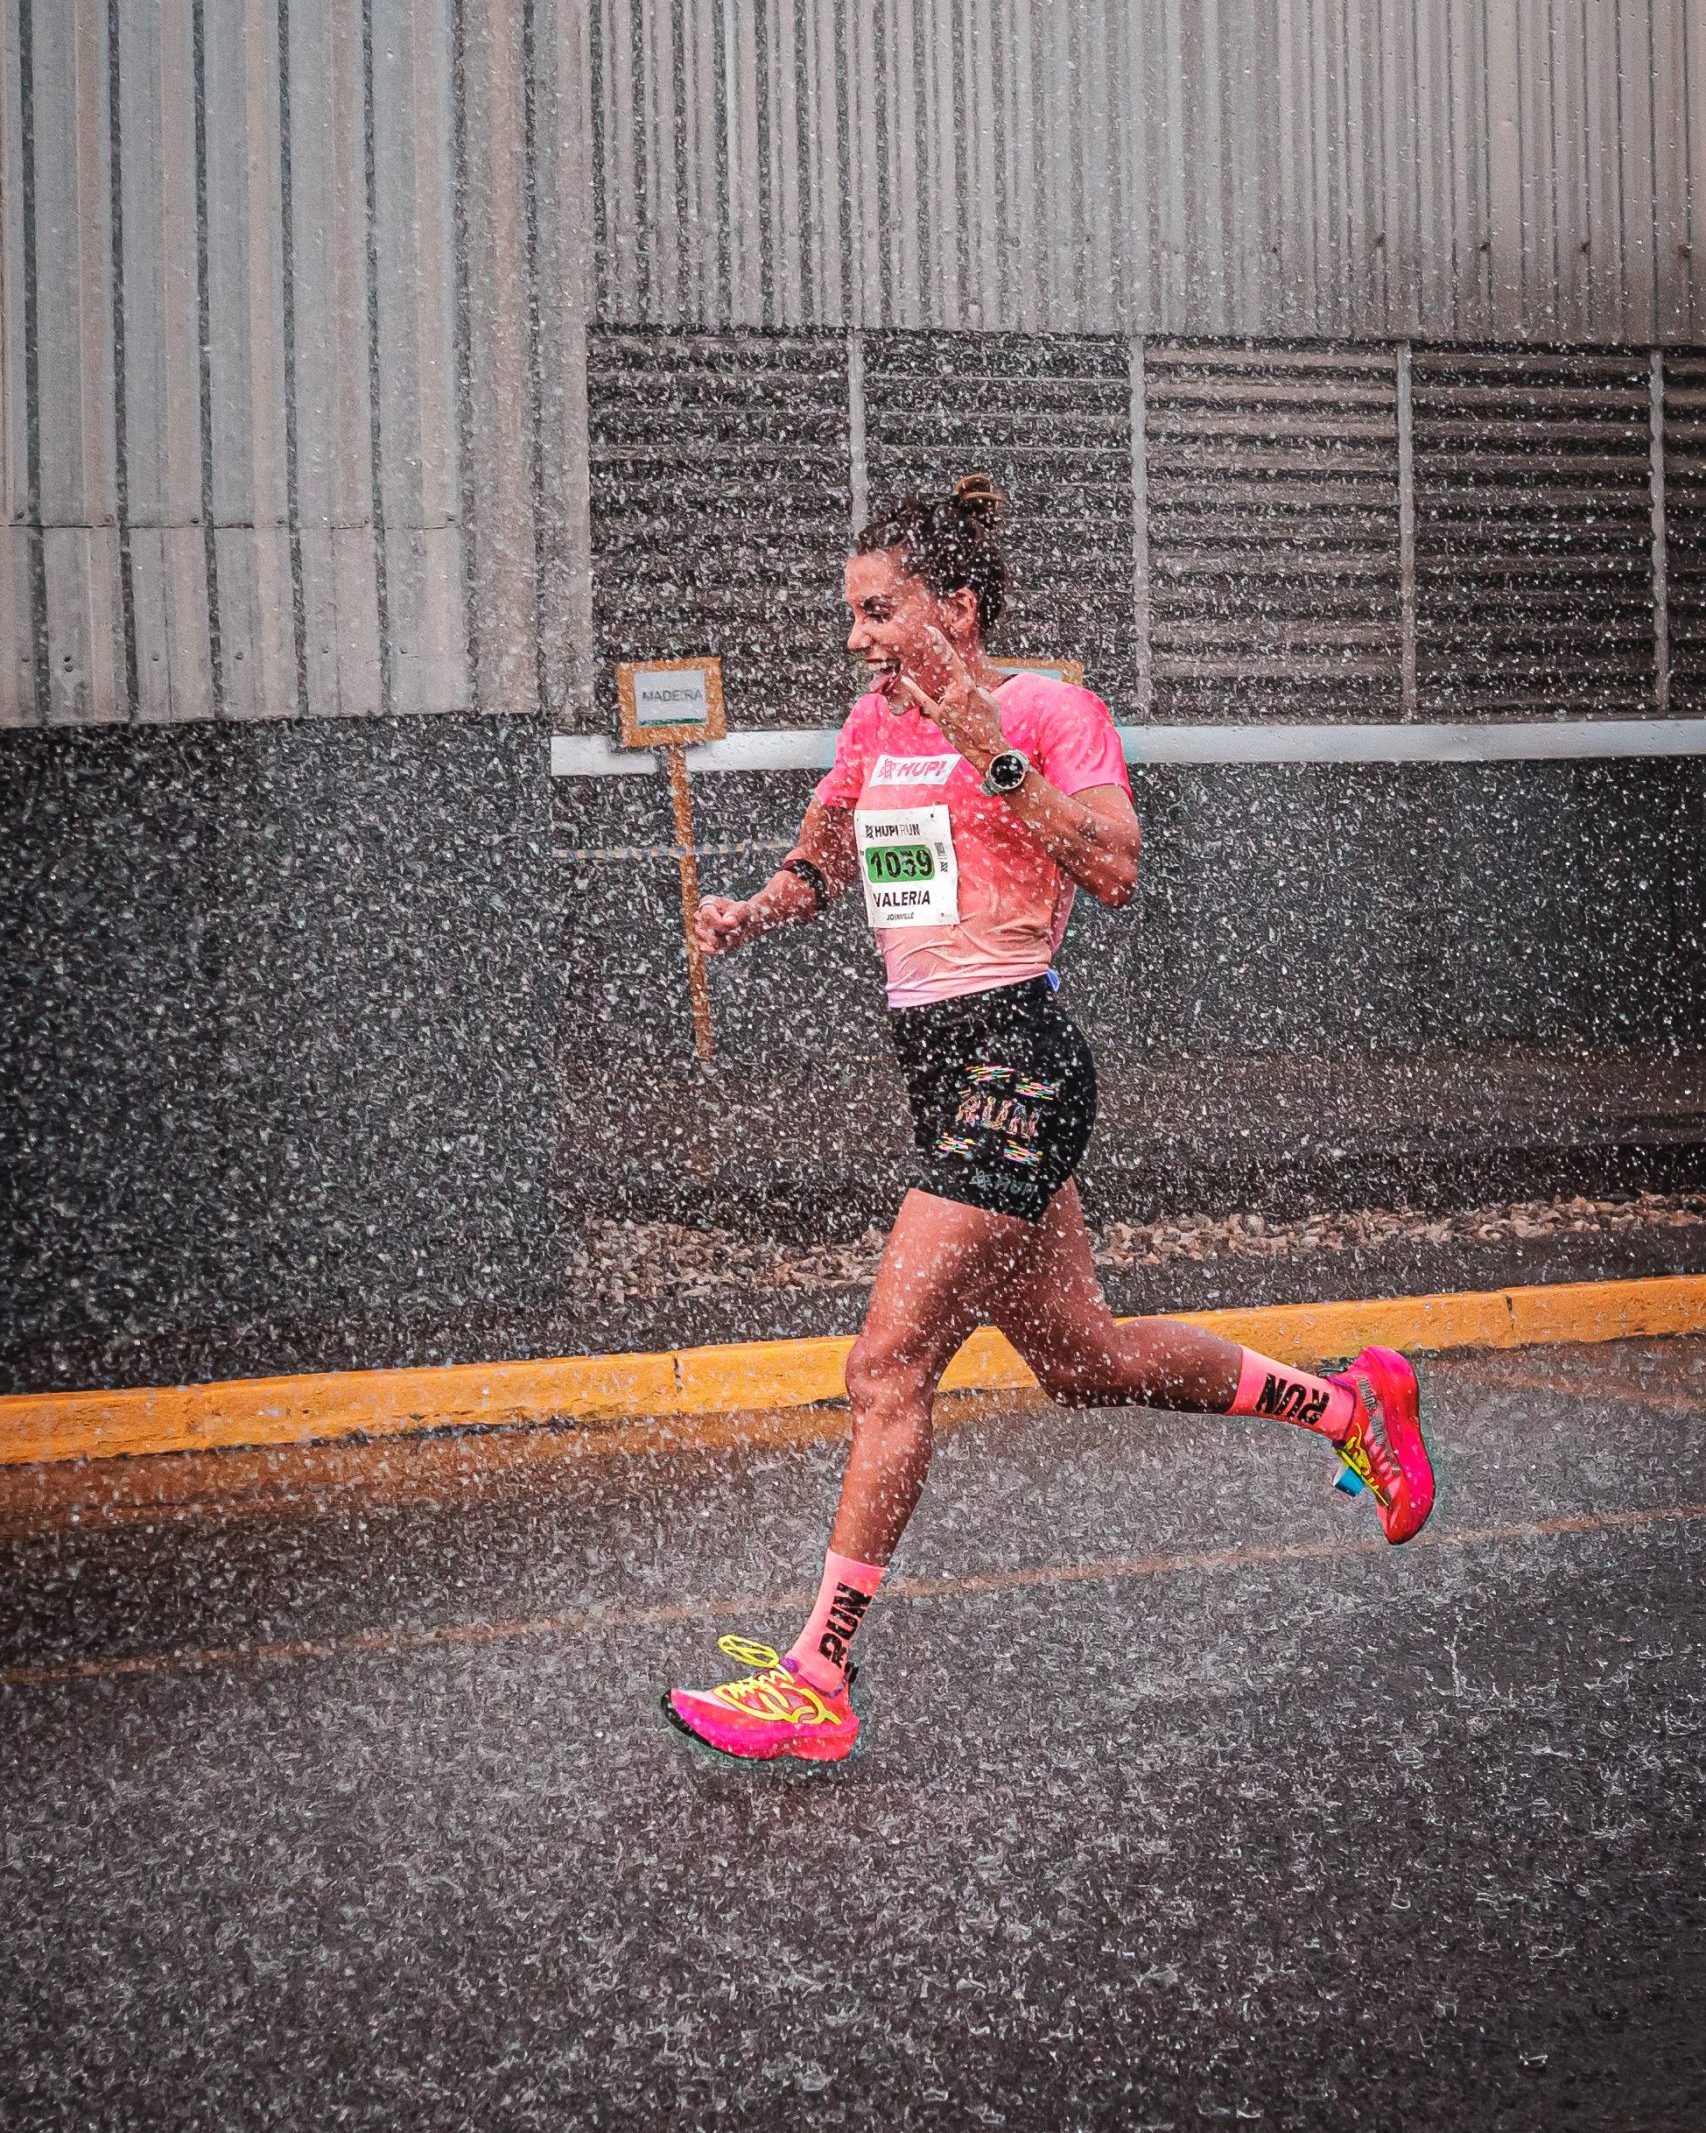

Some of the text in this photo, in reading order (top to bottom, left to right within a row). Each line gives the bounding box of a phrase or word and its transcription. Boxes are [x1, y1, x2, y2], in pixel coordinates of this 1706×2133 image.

[897, 761, 947, 776] HUPI
[875, 823, 920, 837] HUPI RUN
[873, 890, 931, 907] VALERIA
[955, 1094, 1041, 1141] RUN
[1255, 1373, 1330, 1425] RUN
[818, 1582, 873, 1669] RUN
